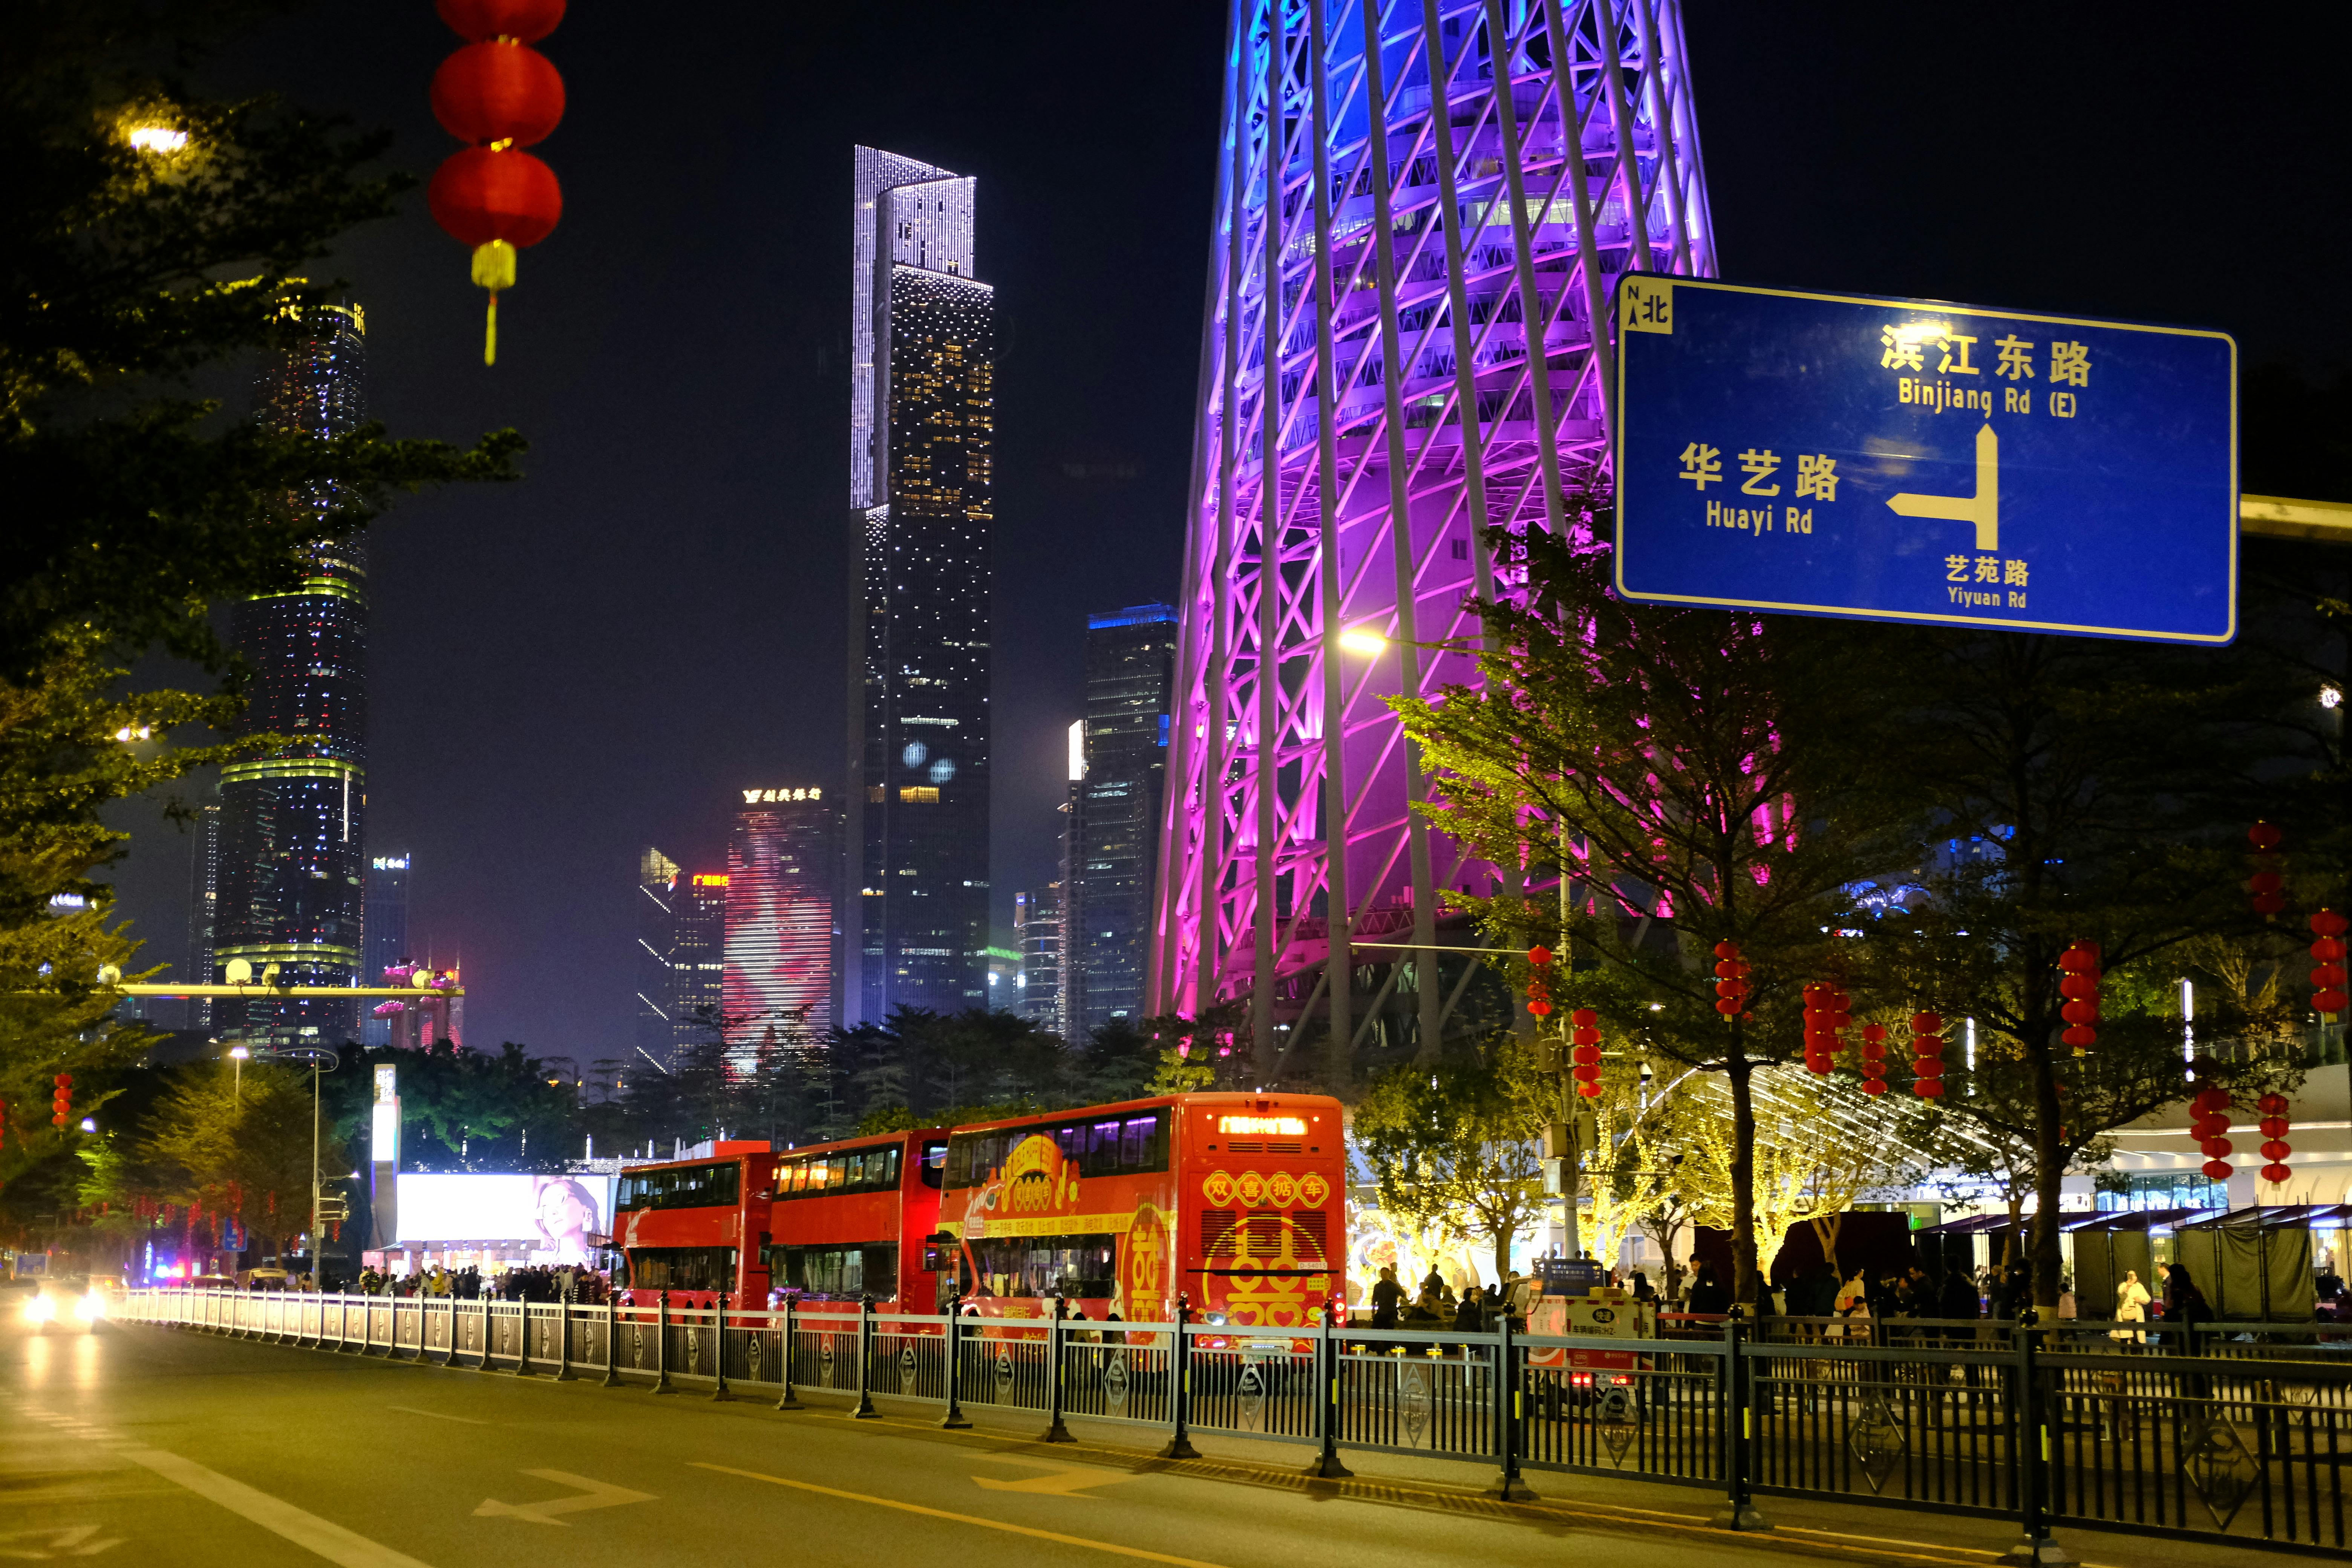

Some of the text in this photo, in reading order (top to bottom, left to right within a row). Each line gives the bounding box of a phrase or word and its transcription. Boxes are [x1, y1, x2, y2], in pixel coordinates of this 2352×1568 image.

[1628, 285, 1639, 300] N
[1642, 295, 1668, 323] 北
[1880, 324, 2092, 387] 滨江东路
[1899, 378, 2076, 418] Binjiang Rd (E)
[1679, 442, 1840, 501] 华艺路
[1707, 500, 1812, 536] Huayi Rd
[1945, 554, 2030, 586] 艺苑路
[1948, 586, 2027, 608] Yiyuan Rd
